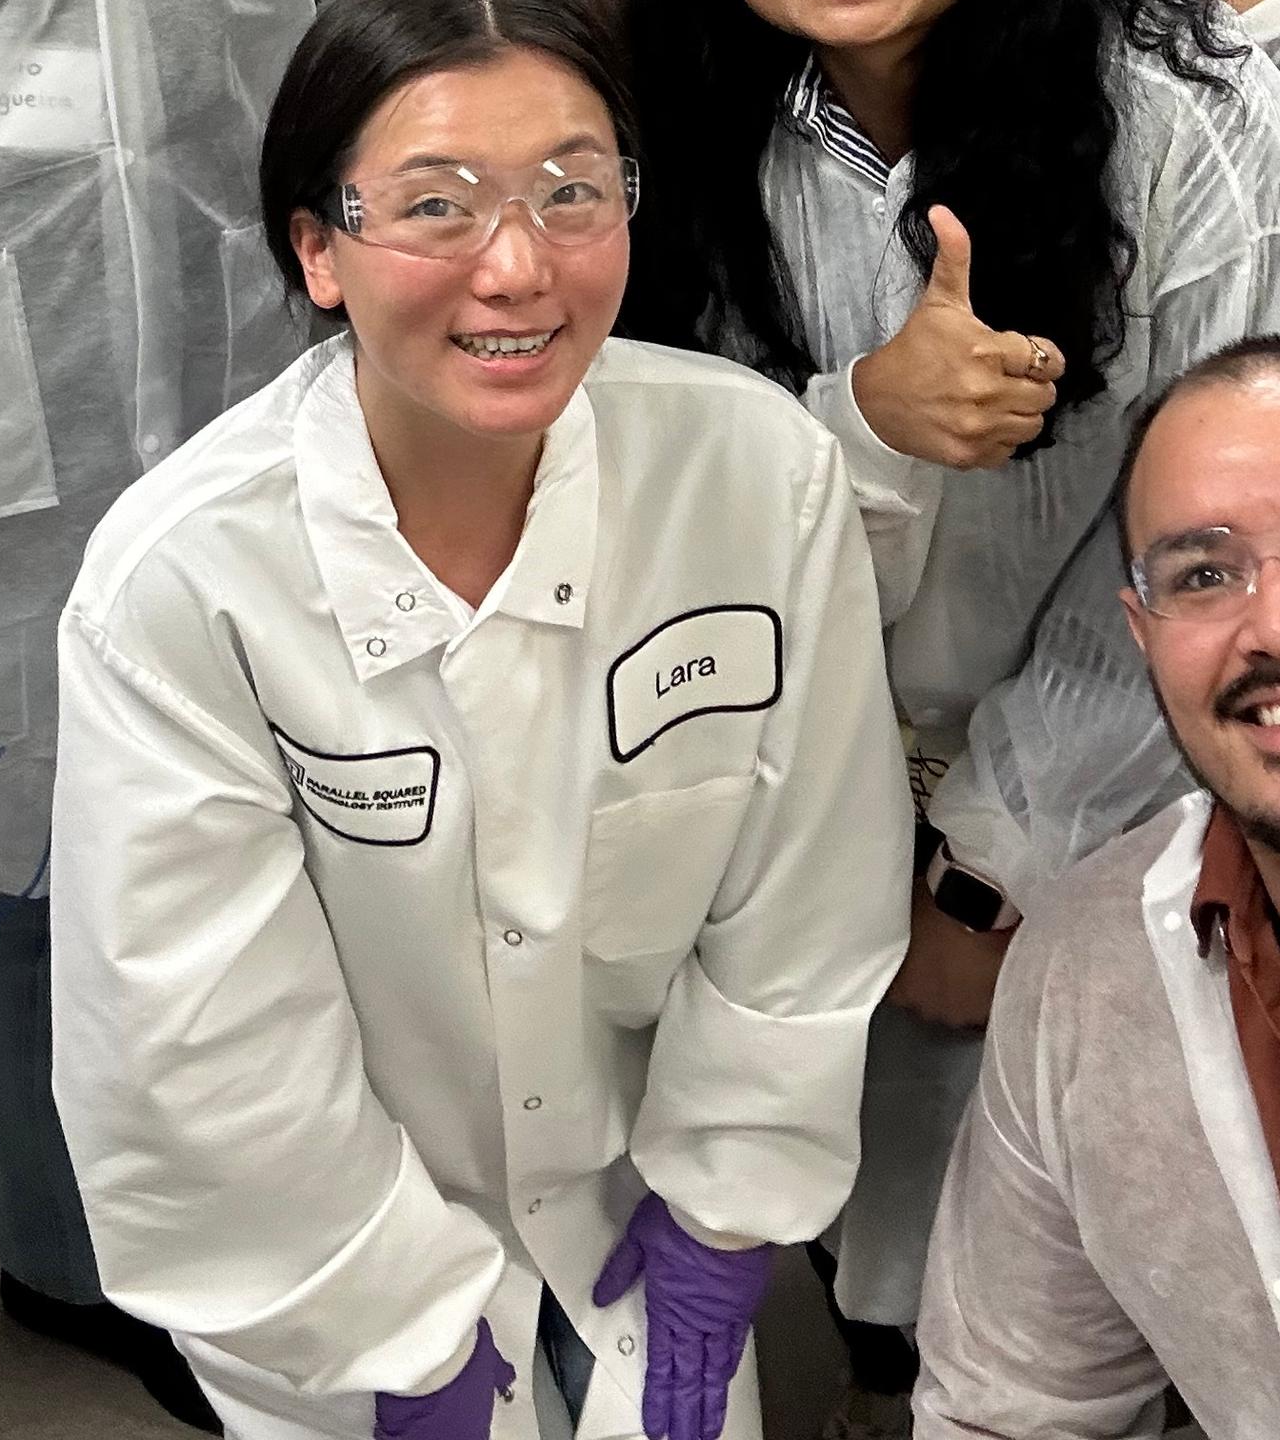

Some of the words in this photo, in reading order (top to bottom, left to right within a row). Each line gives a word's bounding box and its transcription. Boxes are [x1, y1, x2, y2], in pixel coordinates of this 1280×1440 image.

[656, 656, 716, 699] Lara
[307, 777, 369, 801] PARALLEL
[373, 785, 426, 802] SQUARED
[376, 797, 424, 810] INSTITUTE
